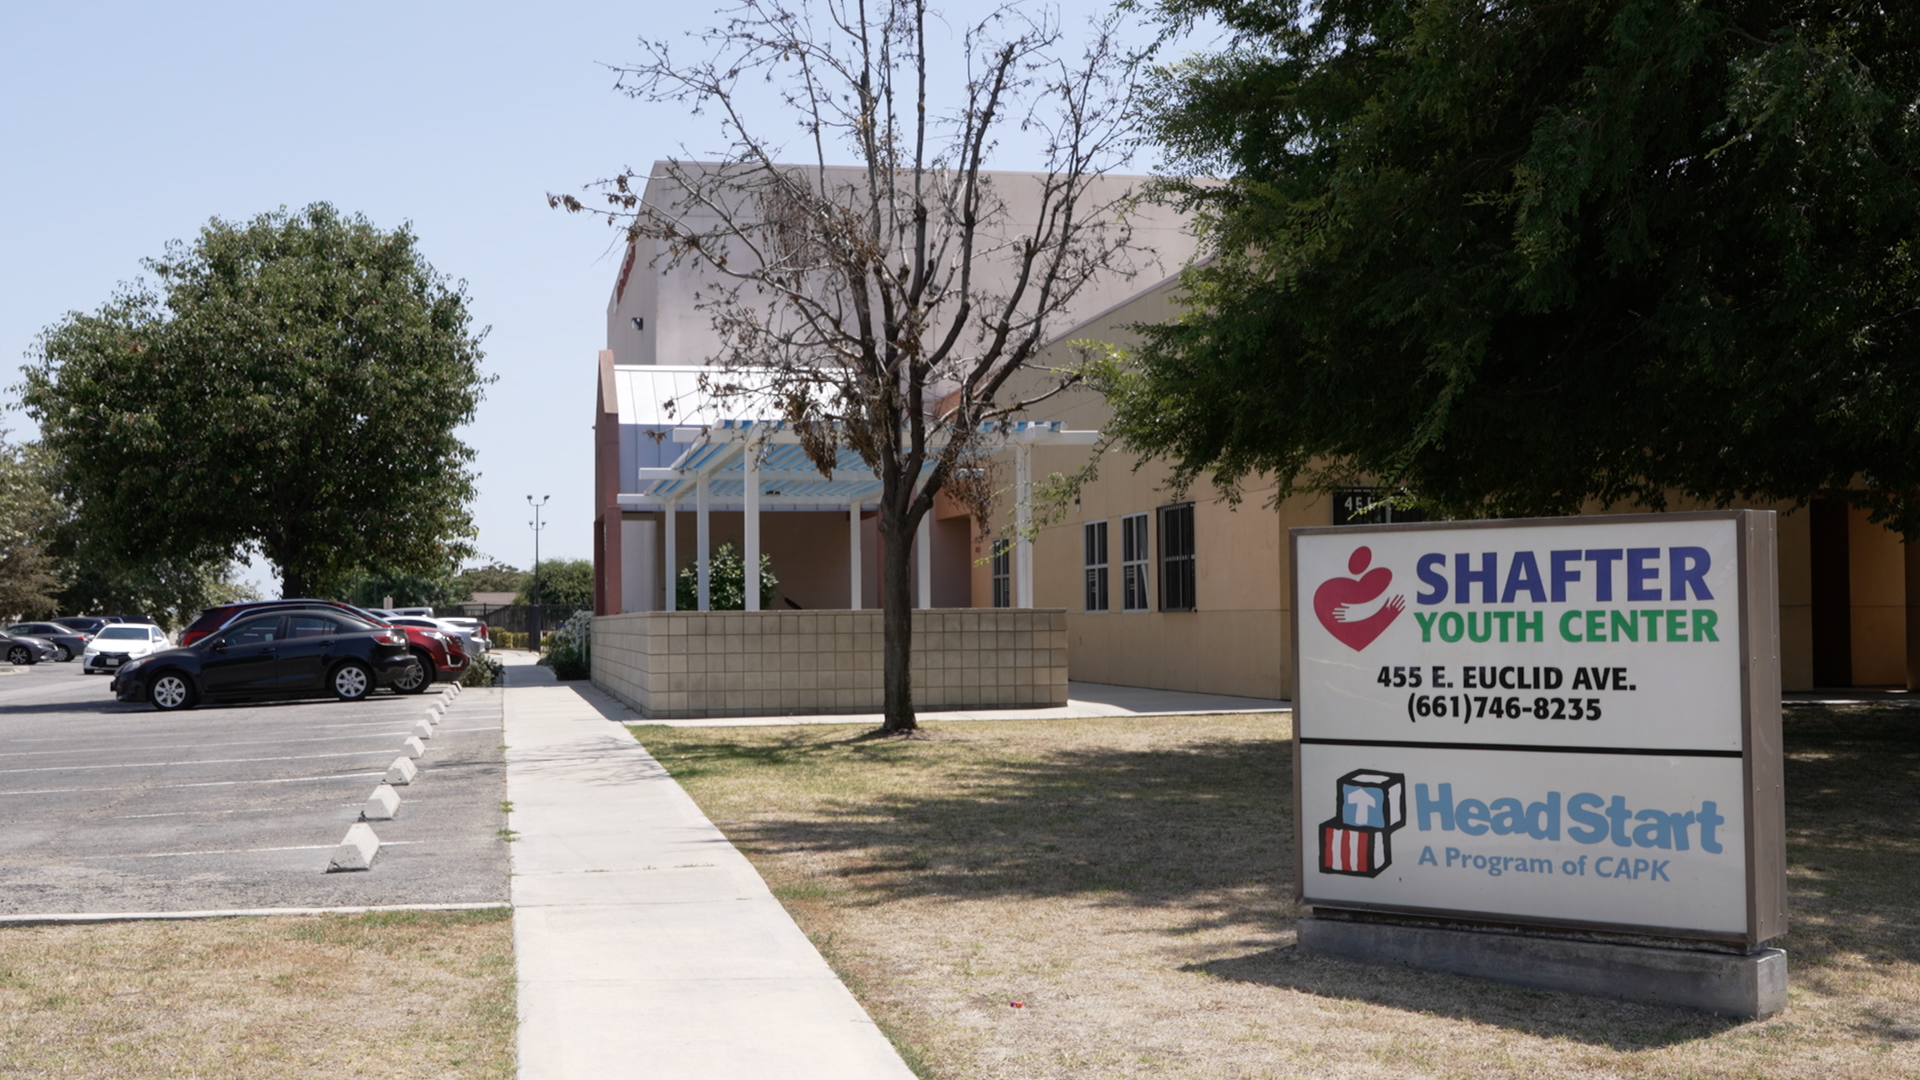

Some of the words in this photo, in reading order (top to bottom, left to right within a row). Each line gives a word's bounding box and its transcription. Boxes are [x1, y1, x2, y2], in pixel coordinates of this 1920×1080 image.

[1415, 546, 1715, 605] SHAFTER
[1414, 611, 1544, 643] YOUTH
[1558, 609, 1720, 643] CENTER
[1377, 666, 1422, 689] 455
[1432, 666, 1454, 689] E.
[1463, 666, 1563, 690] EUCLID
[1572, 667, 1637, 691] AVE.
[1407, 693, 1602, 724] (661)746-8235
[1418, 846, 1438, 866] A
[1446, 847, 1553, 876] Program
[1562, 855, 1587, 876] of
[1595, 857, 1671, 882] CAPK
